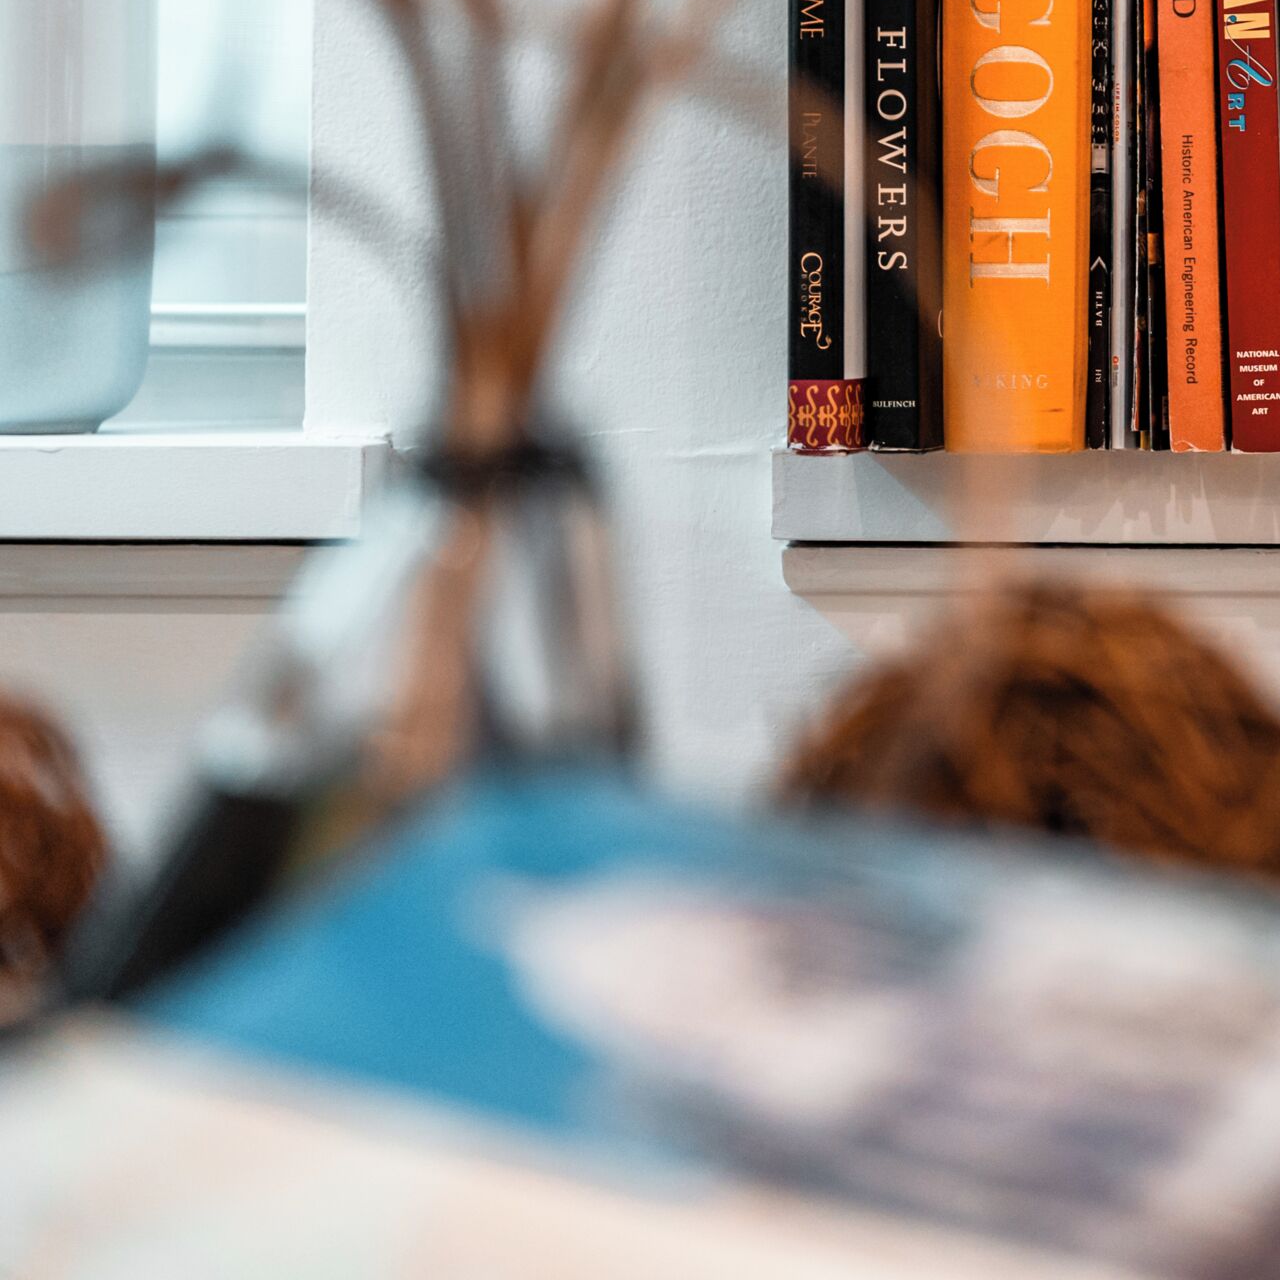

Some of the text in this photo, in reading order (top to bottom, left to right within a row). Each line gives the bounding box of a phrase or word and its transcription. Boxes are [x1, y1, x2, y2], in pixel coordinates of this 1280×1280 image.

[802, 112, 823, 179] PLANTE
[876, 25, 908, 271] FLOWERS
[1181, 134, 1198, 385] Historic American Engineering Record
[800, 252, 832, 350] COURAGE
[1095, 290, 1103, 327] BATH
[1236, 349, 1280, 359] NATIONAL
[1239, 363, 1278, 372] MUSEUM
[1095, 368, 1103, 383] RH
[1253, 378, 1265, 387] OF
[872, 400, 916, 409] BULFINCH
[1251, 406, 1268, 415] ART
